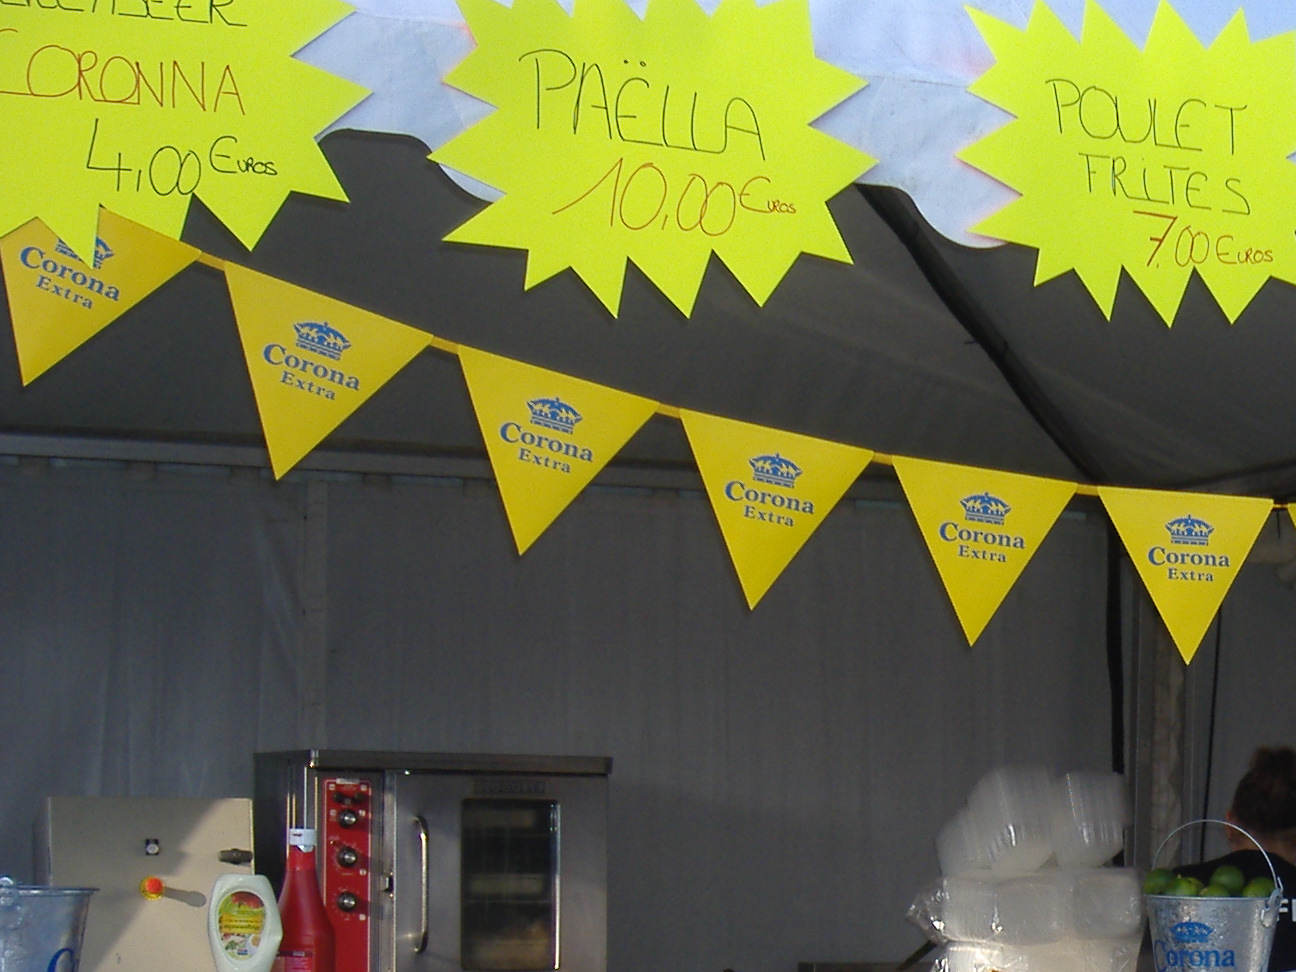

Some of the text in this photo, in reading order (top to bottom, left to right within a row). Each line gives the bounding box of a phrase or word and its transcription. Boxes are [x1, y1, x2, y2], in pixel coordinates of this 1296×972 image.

[1045, 78, 1249, 155] POULET
[1079, 152, 1250, 216] FRITES
[19, 246, 121, 302] Corona
[36, 275, 94, 310] Extra
[262, 343, 360, 391] Corona
[280, 371, 337, 401] Extra
[499, 421, 594, 463] Corona
[518, 447, 572, 475] Extra
[724, 480, 815, 516] Corona
[743, 505, 795, 528] Extra
[938, 521, 1026, 550] Corona
[957, 544, 1008, 563] Extra
[1147, 546, 1231, 568] Corona
[1167, 567, 1215, 583] Extra
